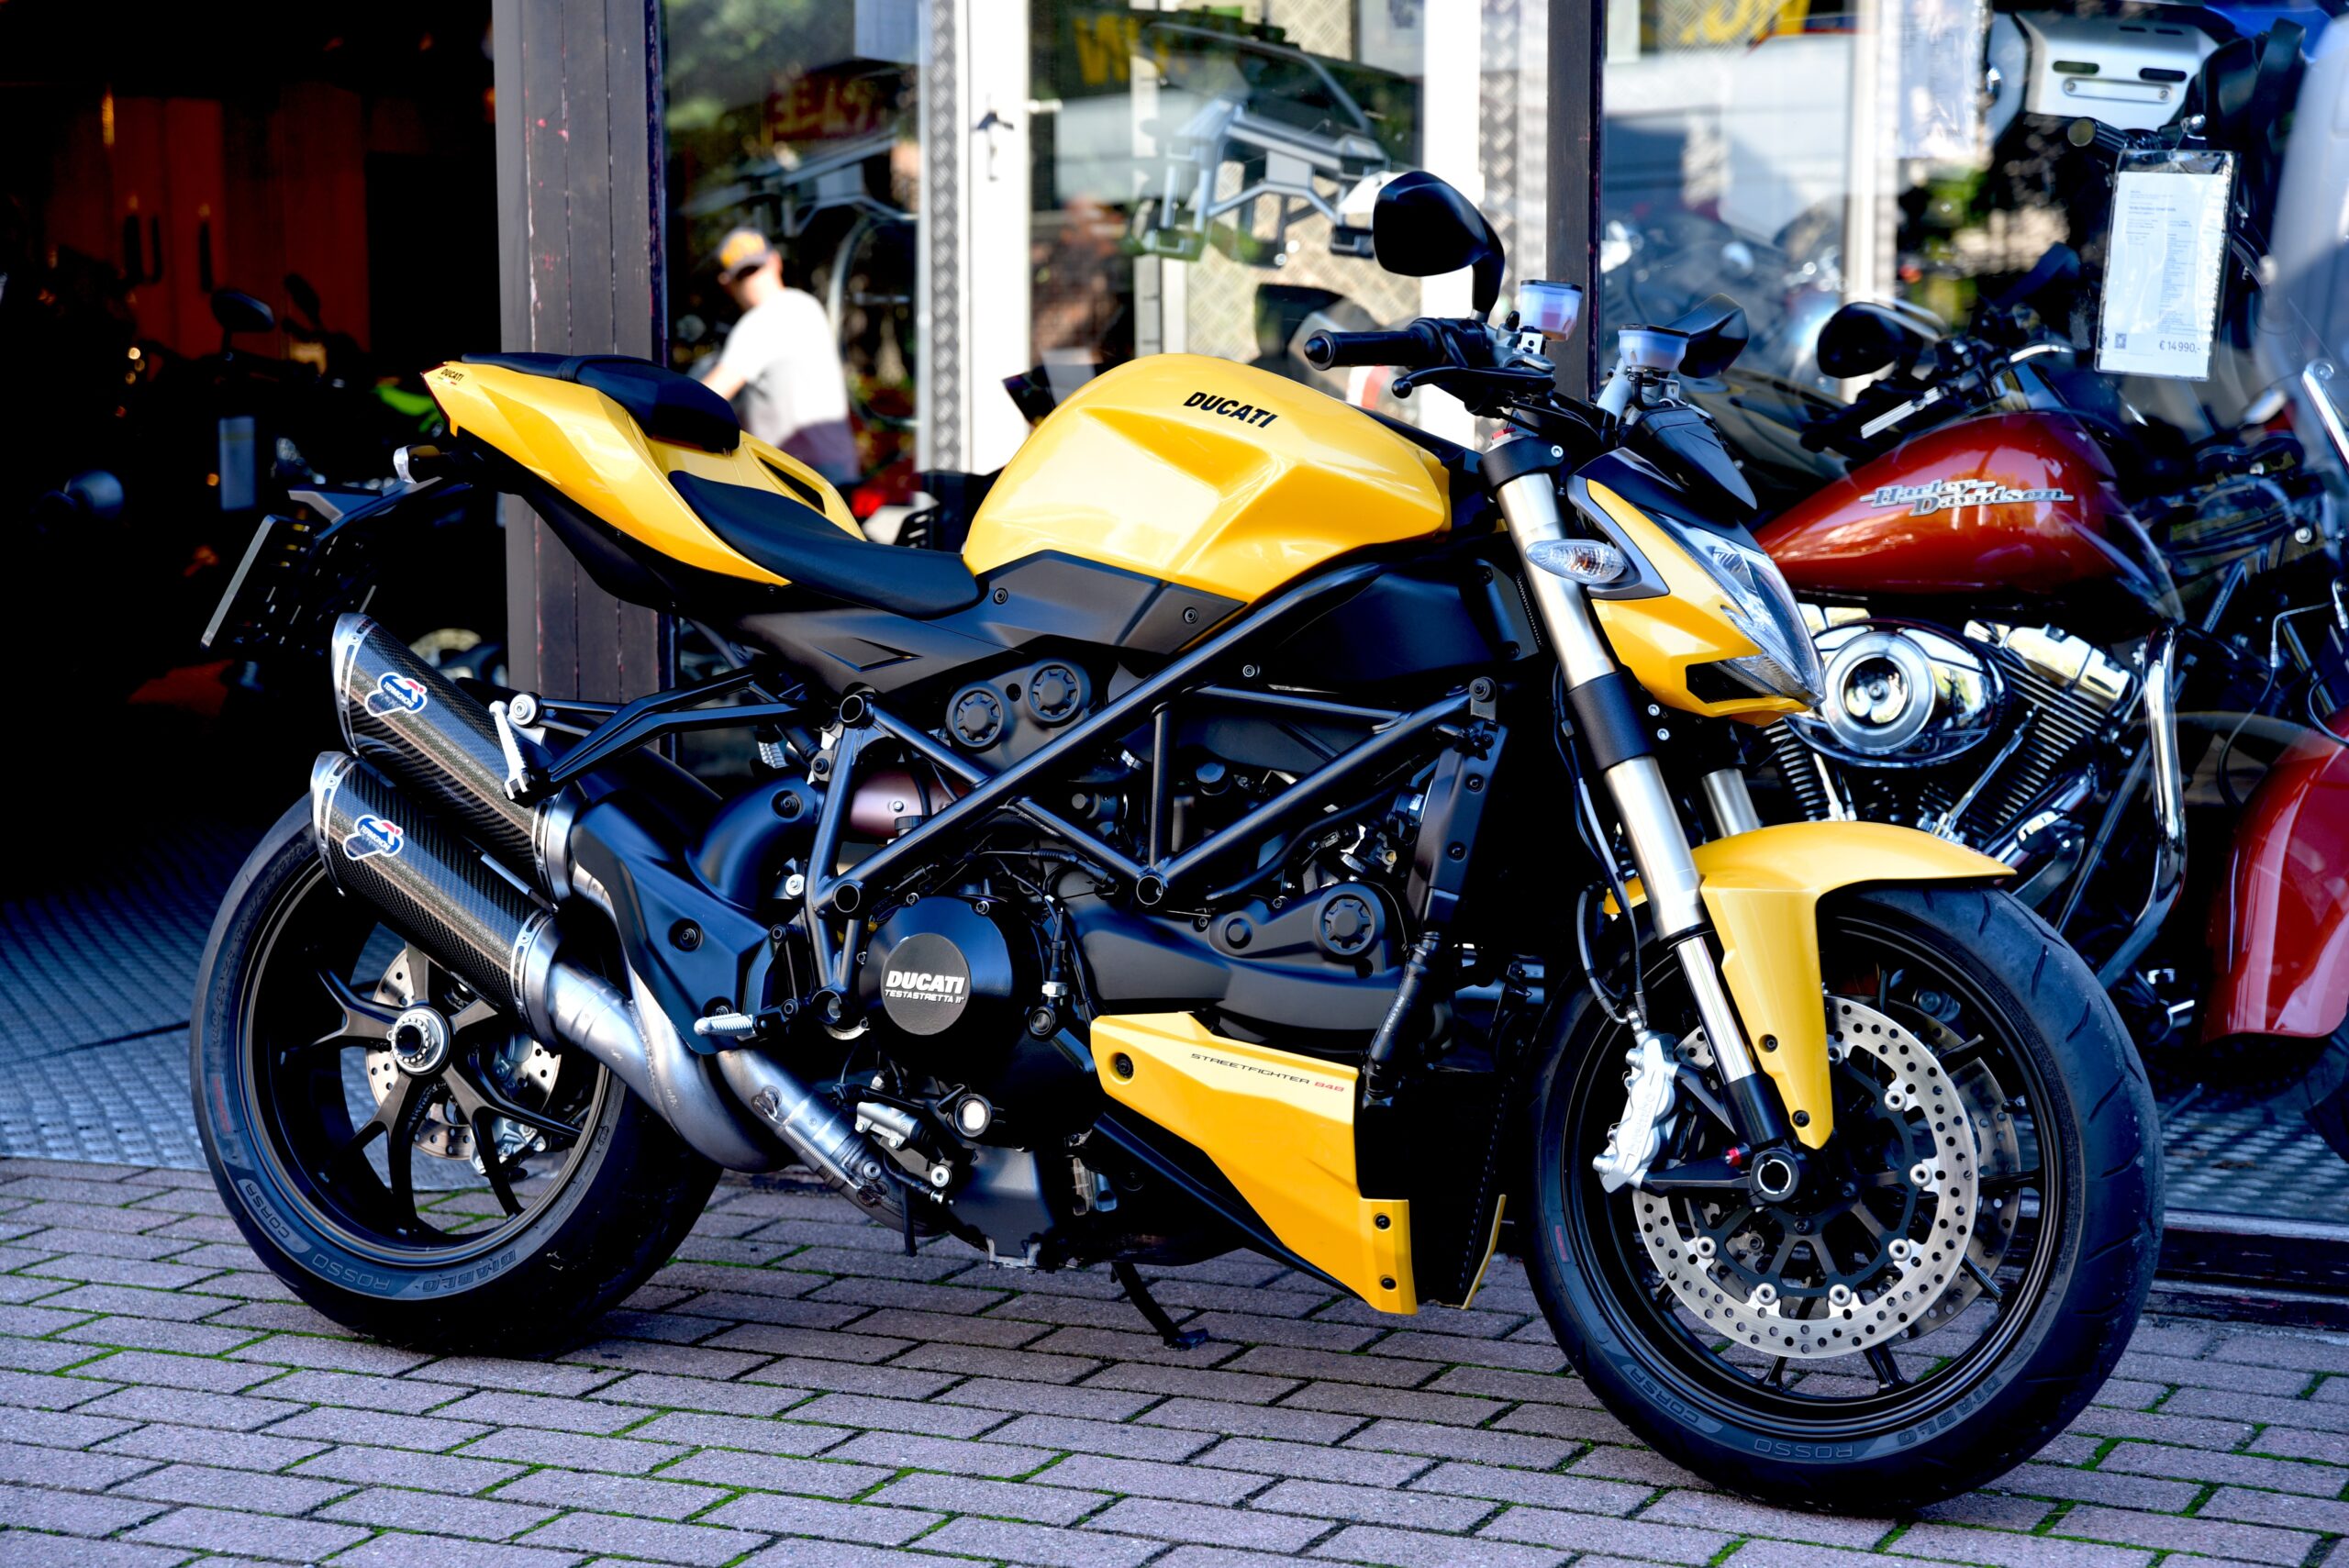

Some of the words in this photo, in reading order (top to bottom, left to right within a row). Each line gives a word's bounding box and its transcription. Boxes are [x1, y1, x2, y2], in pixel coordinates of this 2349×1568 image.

[440, 368, 464, 382] DUCATI
[1183, 391, 1279, 428] DUCATI
[383, 681, 415, 708] TERMIGNONI
[360, 824, 392, 851] TERMIGNONI
[885, 970, 966, 995] DUCATI
[885, 989, 953, 1004] TESTASTRETTA
[1191, 1052, 1311, 1084] STREETFIGHTER
[1314, 1081, 1345, 1093] 848
[1631, 1092, 1657, 1152] brembo
[245, 1183, 291, 1239] CORSA
[312, 1253, 390, 1290] ROSSO
[422, 1249, 517, 1293] DIABLO
[1630, 1367, 1699, 1424] CORSA
[1897, 1375, 2002, 1446] DIABLO
[1753, 1438, 1854, 1459] ROSSO
